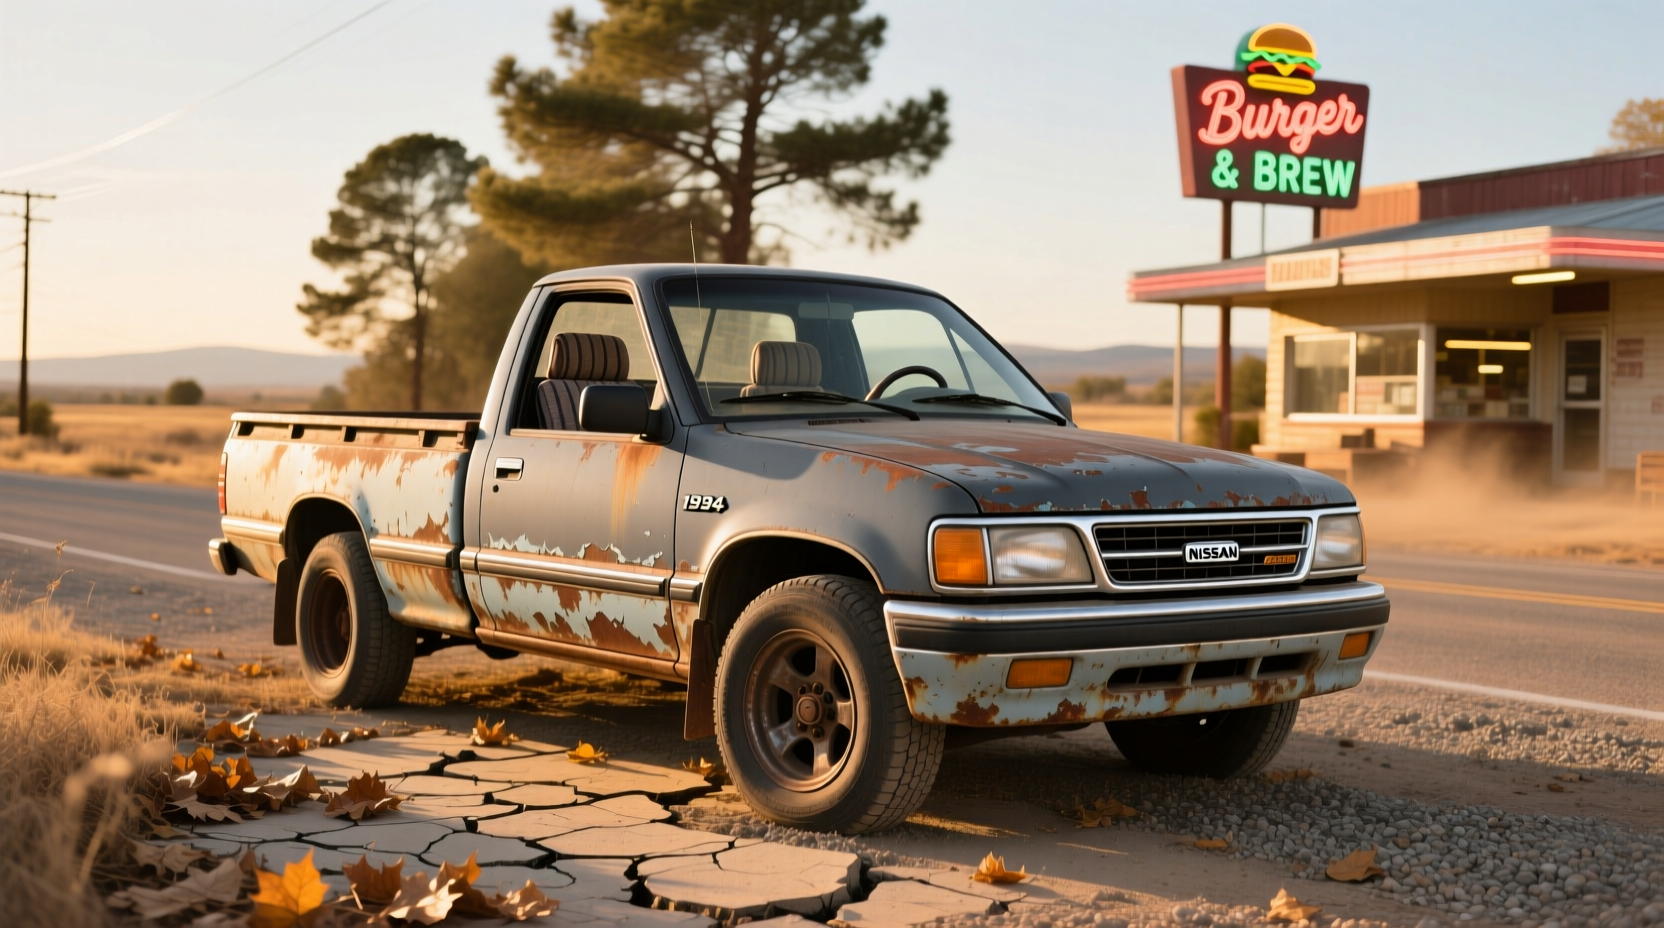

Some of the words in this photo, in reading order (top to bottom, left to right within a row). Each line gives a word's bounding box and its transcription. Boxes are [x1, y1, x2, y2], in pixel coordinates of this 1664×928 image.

[1198, 79, 1364, 154] Burger
[1211, 148, 1239, 189] &
[1253, 150, 1356, 198] BREW
[682, 494, 725, 512] 1994
[1188, 545, 1238, 561] NISSAN
